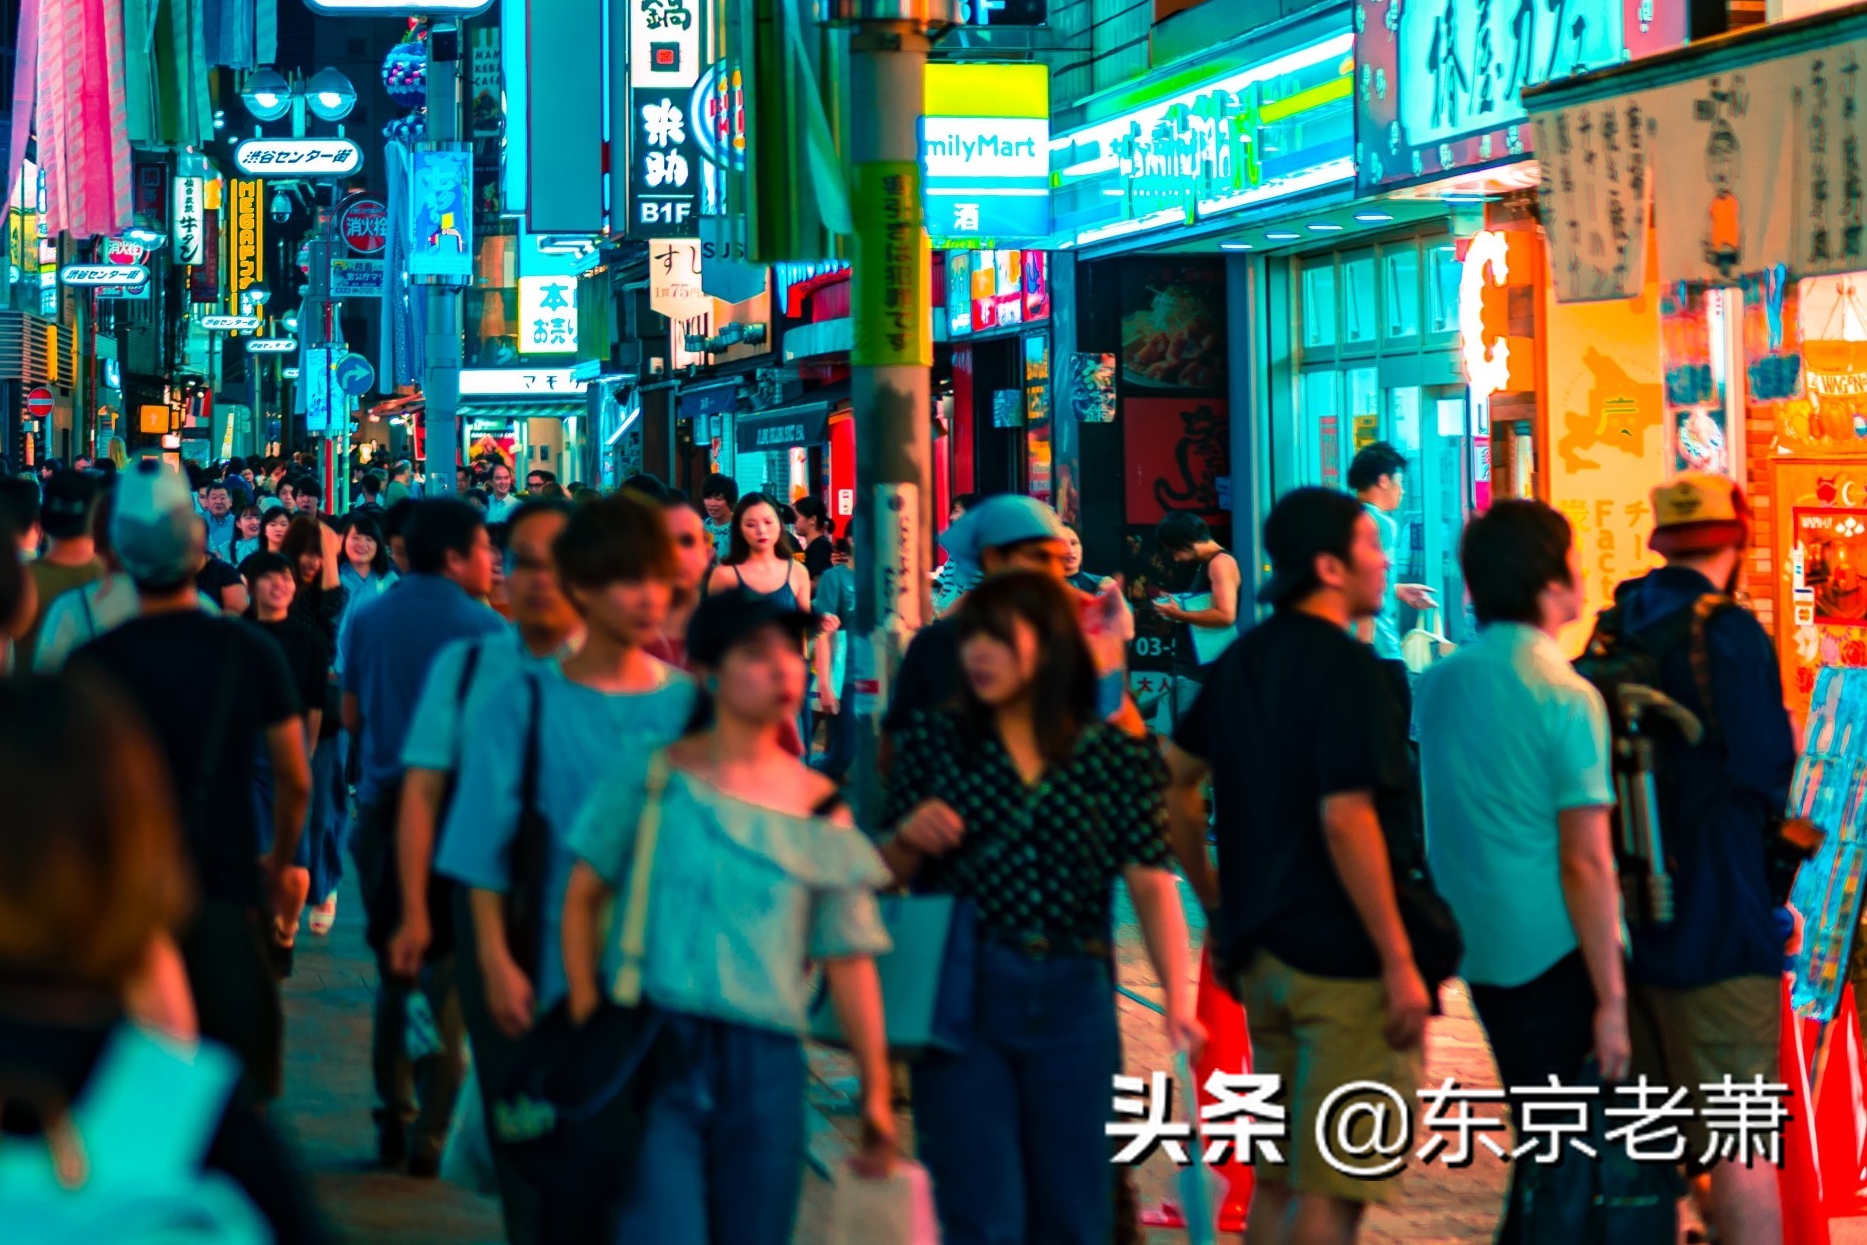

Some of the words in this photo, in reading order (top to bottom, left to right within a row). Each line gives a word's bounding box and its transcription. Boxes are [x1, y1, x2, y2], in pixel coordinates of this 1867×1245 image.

[242, 149, 354, 165] 渋谷センター街
[641, 202, 692, 224] B1F
[953, 203, 980, 231] 酒
[347, 217, 388, 237] 消火栓
[179, 215, 199, 263] 牛タン
[66, 269, 141, 280] 渋谷センター街
